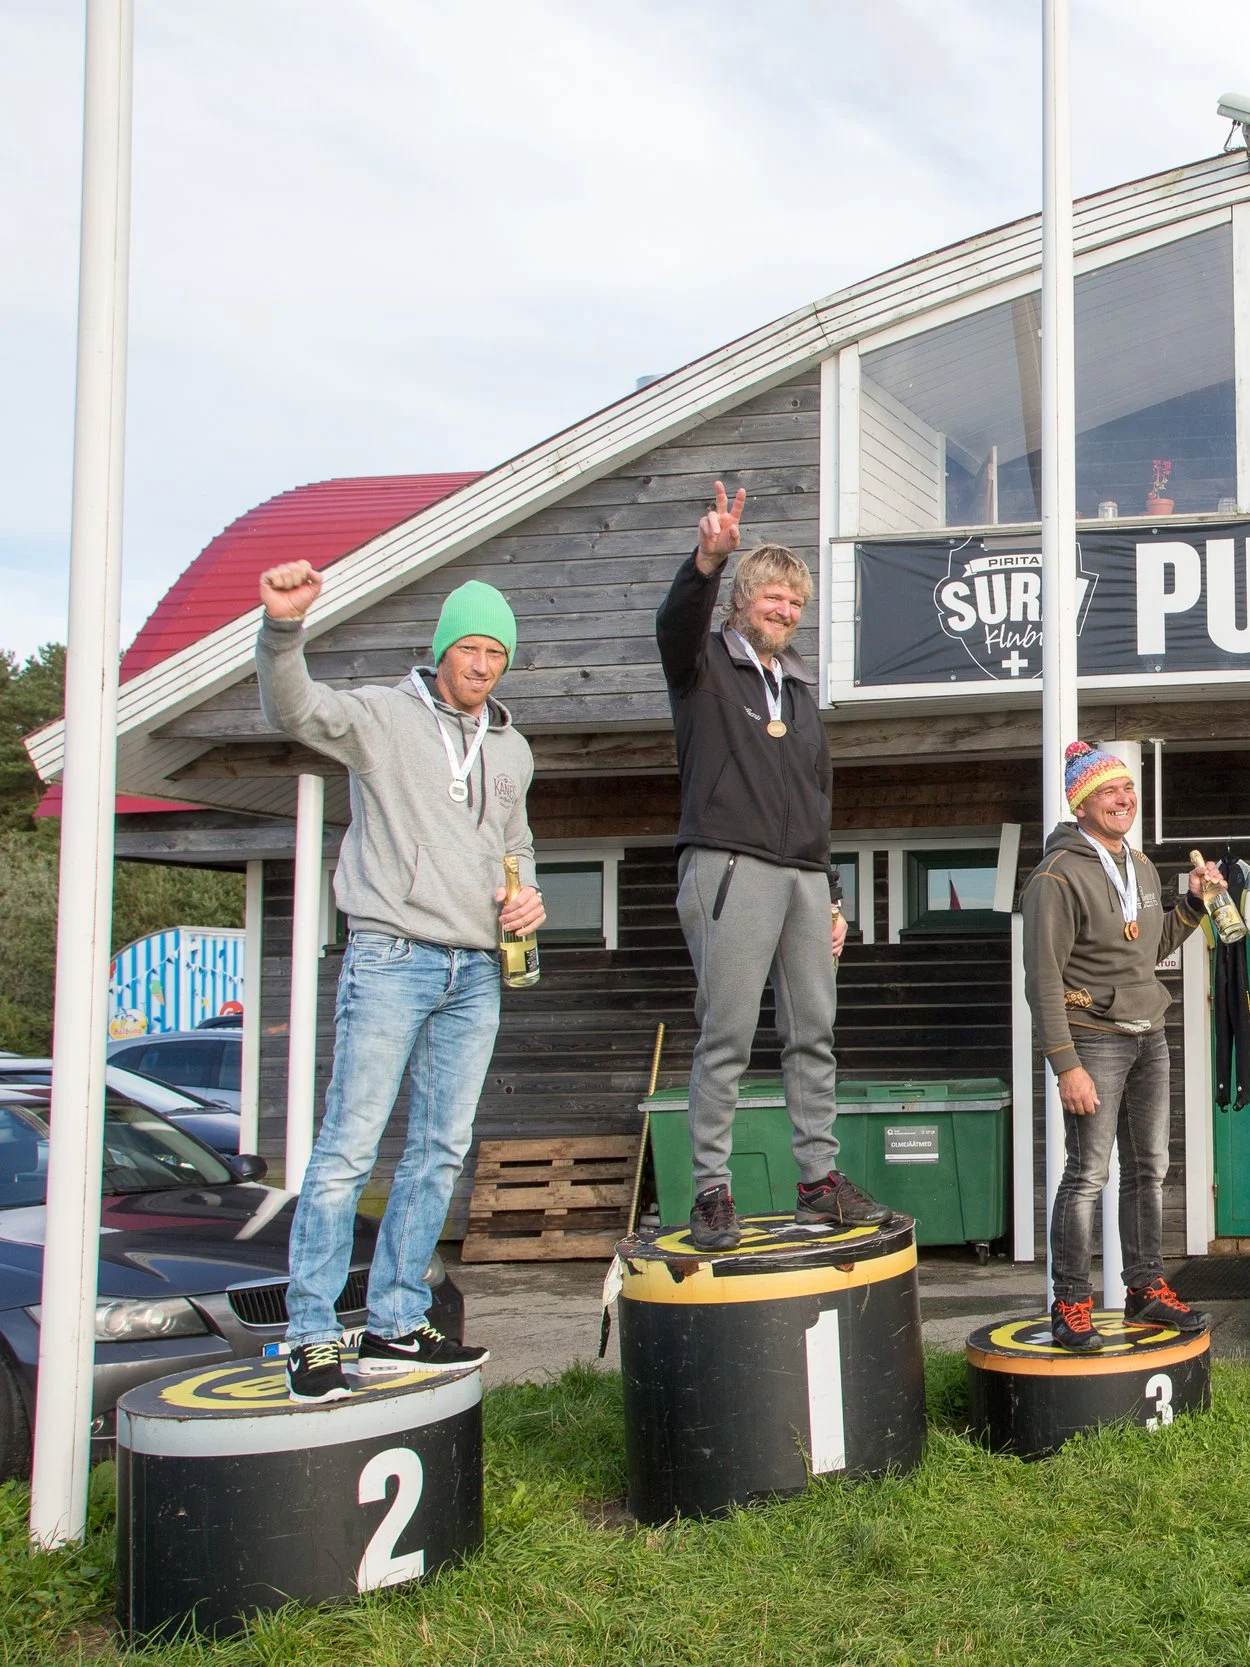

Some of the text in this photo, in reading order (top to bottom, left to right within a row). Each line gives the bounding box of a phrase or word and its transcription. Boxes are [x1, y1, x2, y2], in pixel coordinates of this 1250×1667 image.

[988, 556, 1040, 568] PIRITA
[805, 1309, 846, 1475] 1
[1145, 1373, 1174, 1434] 3
[358, 1447, 425, 1594] 2
